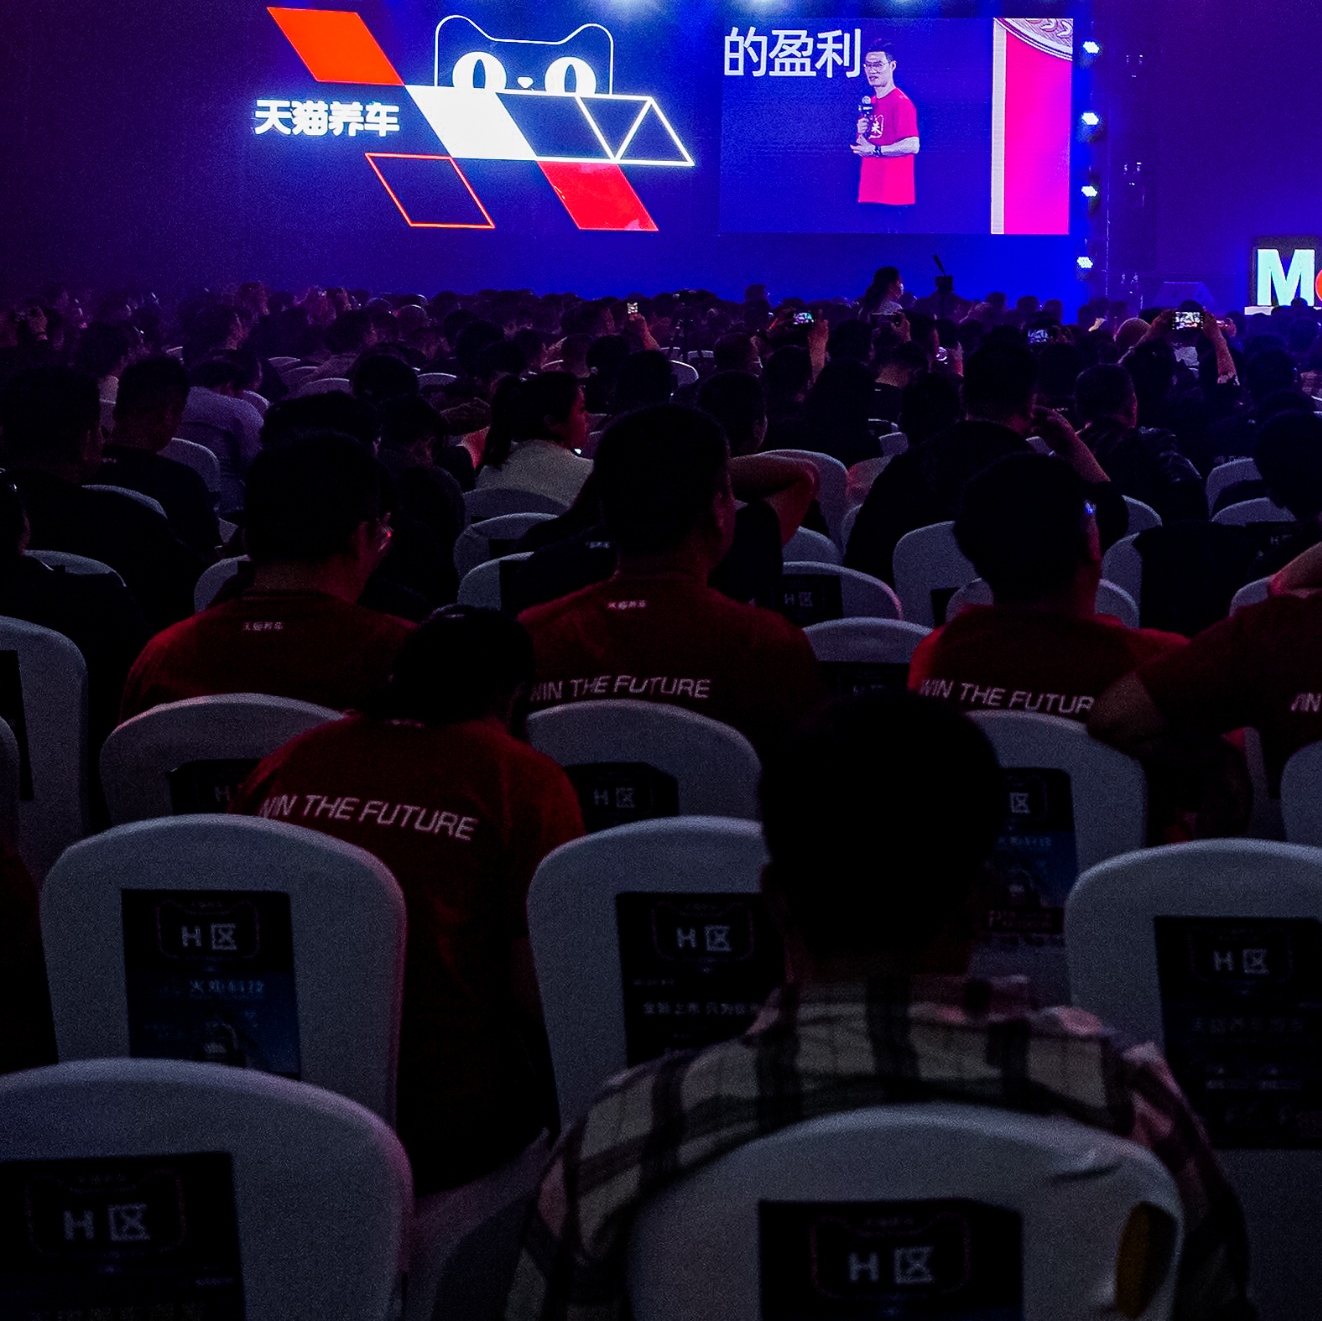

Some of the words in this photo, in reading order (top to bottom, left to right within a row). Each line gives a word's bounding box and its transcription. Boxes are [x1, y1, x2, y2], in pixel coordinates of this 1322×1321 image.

[724, 28, 862, 78] 的盈利
[255, 99, 400, 136] 天猫养车
[569, 675, 612, 698] THE
[613, 674, 712, 699] FUTURE
[959, 682, 1006, 707] THE
[1008, 690, 1095, 714] FUTUR
[593, 786, 636, 809] H区
[302, 794, 360, 820] THE
[358, 799, 480, 842] FUTURE
[180, 923, 238, 952] H区
[676, 923, 733, 953] H区
[1213, 947, 1270, 975] H区
[62, 1202, 151, 1243] H区
[846, 1244, 937, 1286] H区
